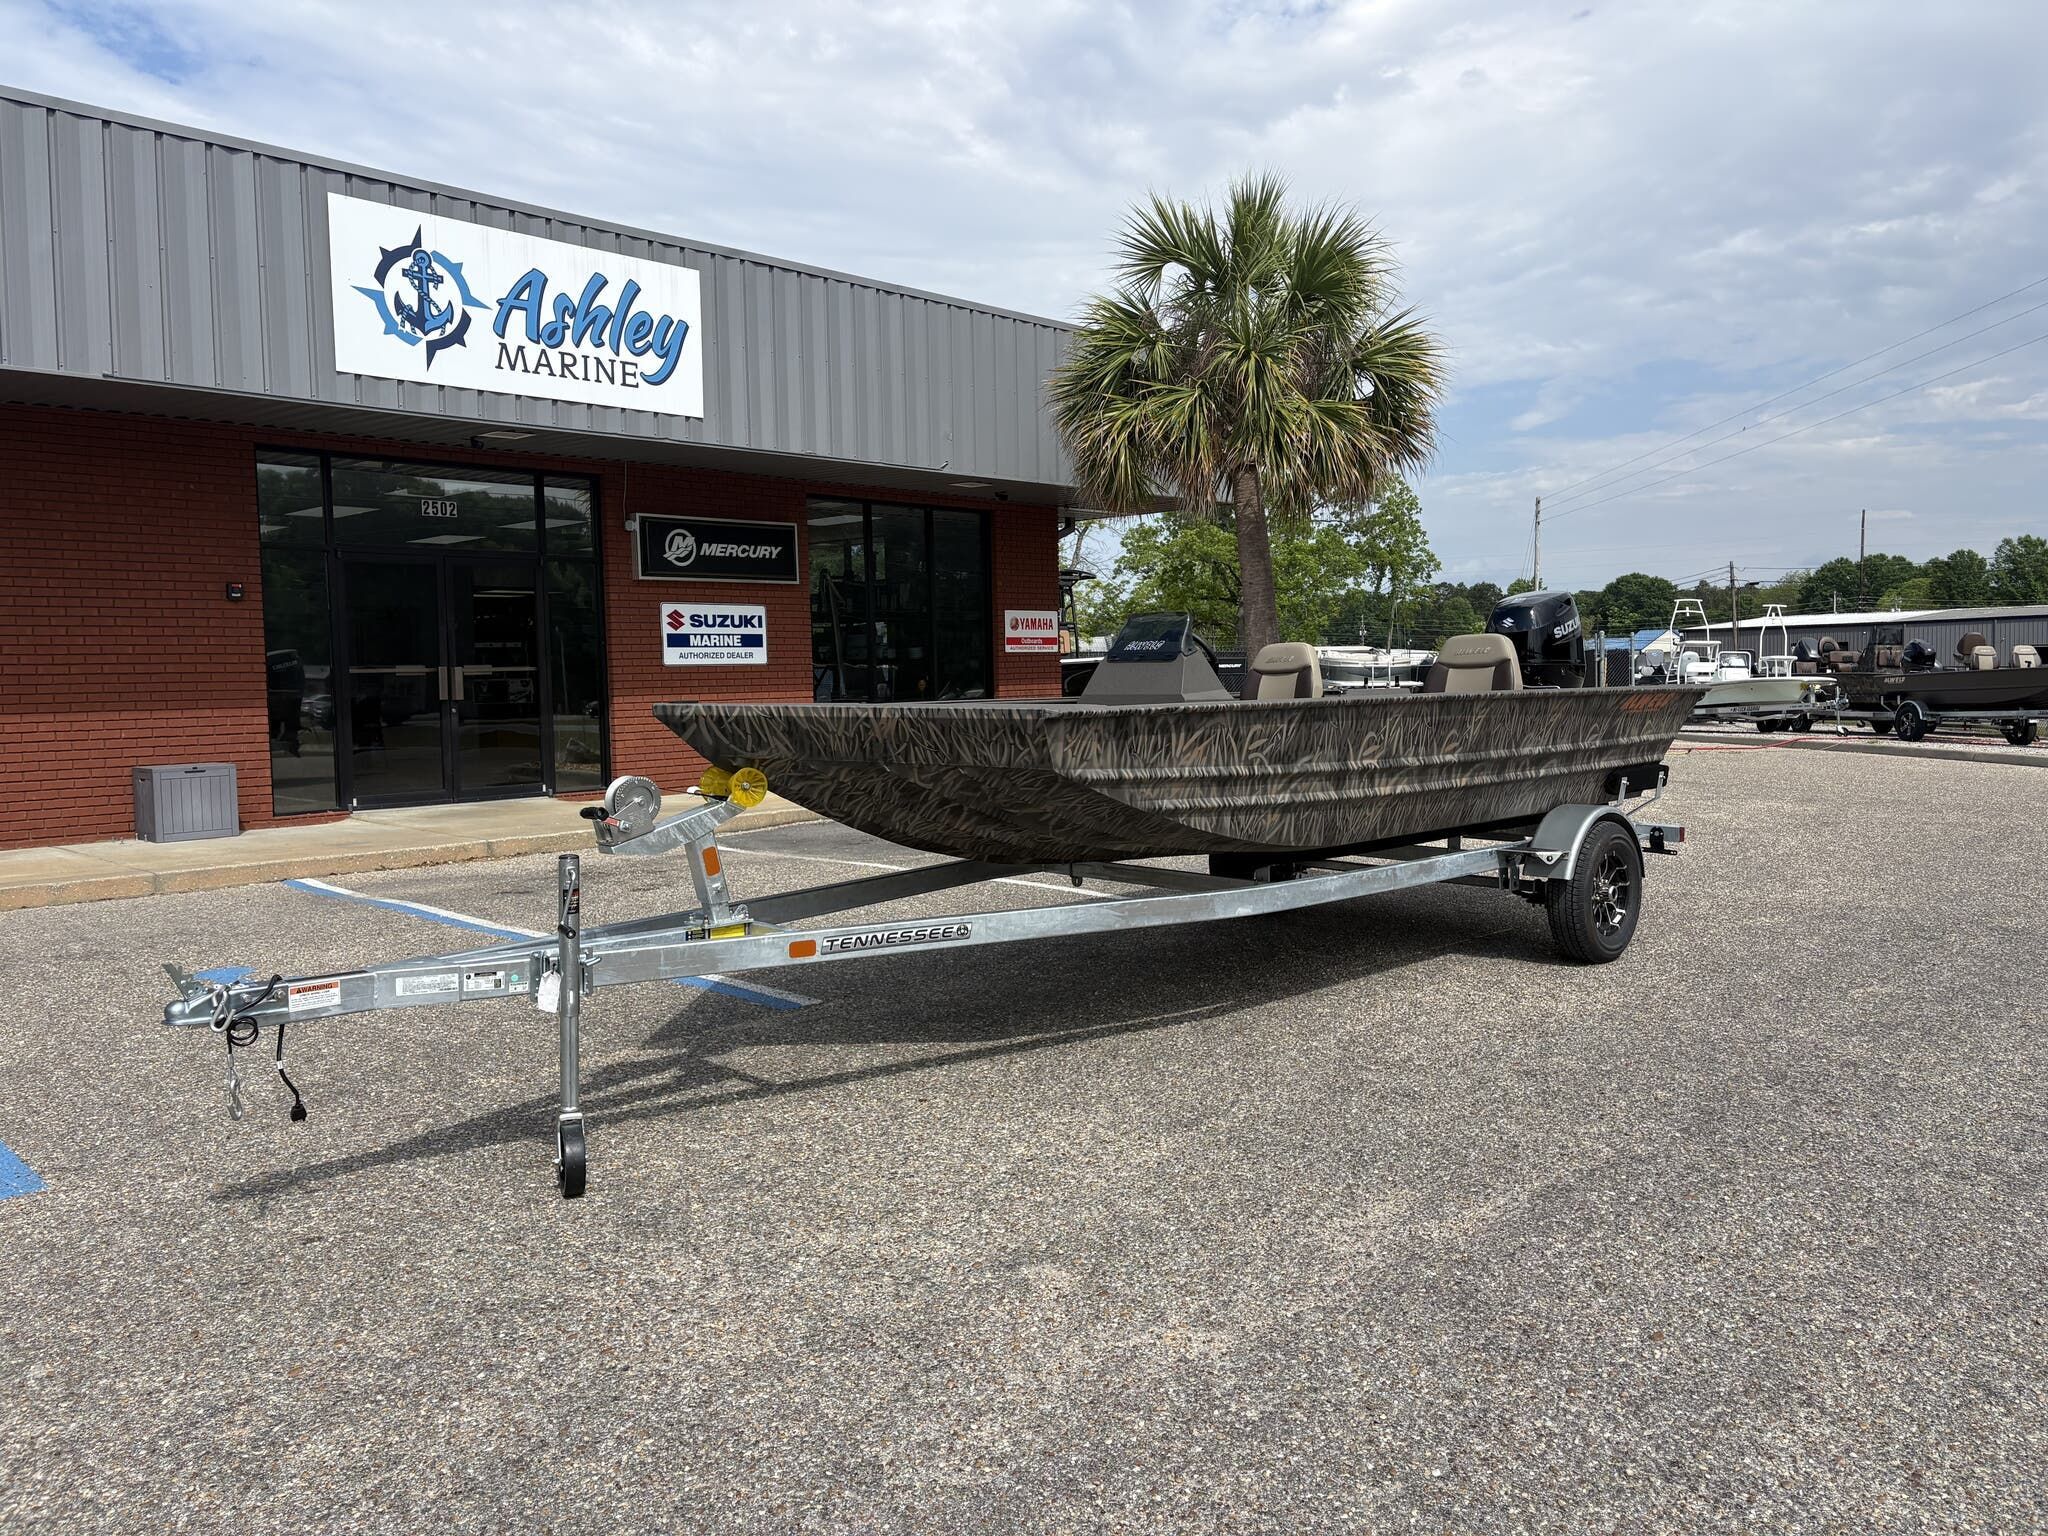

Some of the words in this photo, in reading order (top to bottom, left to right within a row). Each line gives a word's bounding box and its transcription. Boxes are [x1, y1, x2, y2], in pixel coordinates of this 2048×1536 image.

[493, 268, 690, 386] Ashley
[495, 343, 640, 389] MARINE
[422, 500, 456, 517] 2502
[700, 543, 783, 560] MERCURY
[689, 613, 763, 629] SUZUKI
[1020, 617, 1054, 631] YAMAHA
[1553, 615, 1580, 639] SUZU
[689, 634, 742, 647] MARINE
[679, 651, 725, 660] AUTHORIZED
[726, 651, 754, 659] DEALER
[825, 926, 954, 951] TENNESSEE
[302, 982, 333, 993] WARNING
